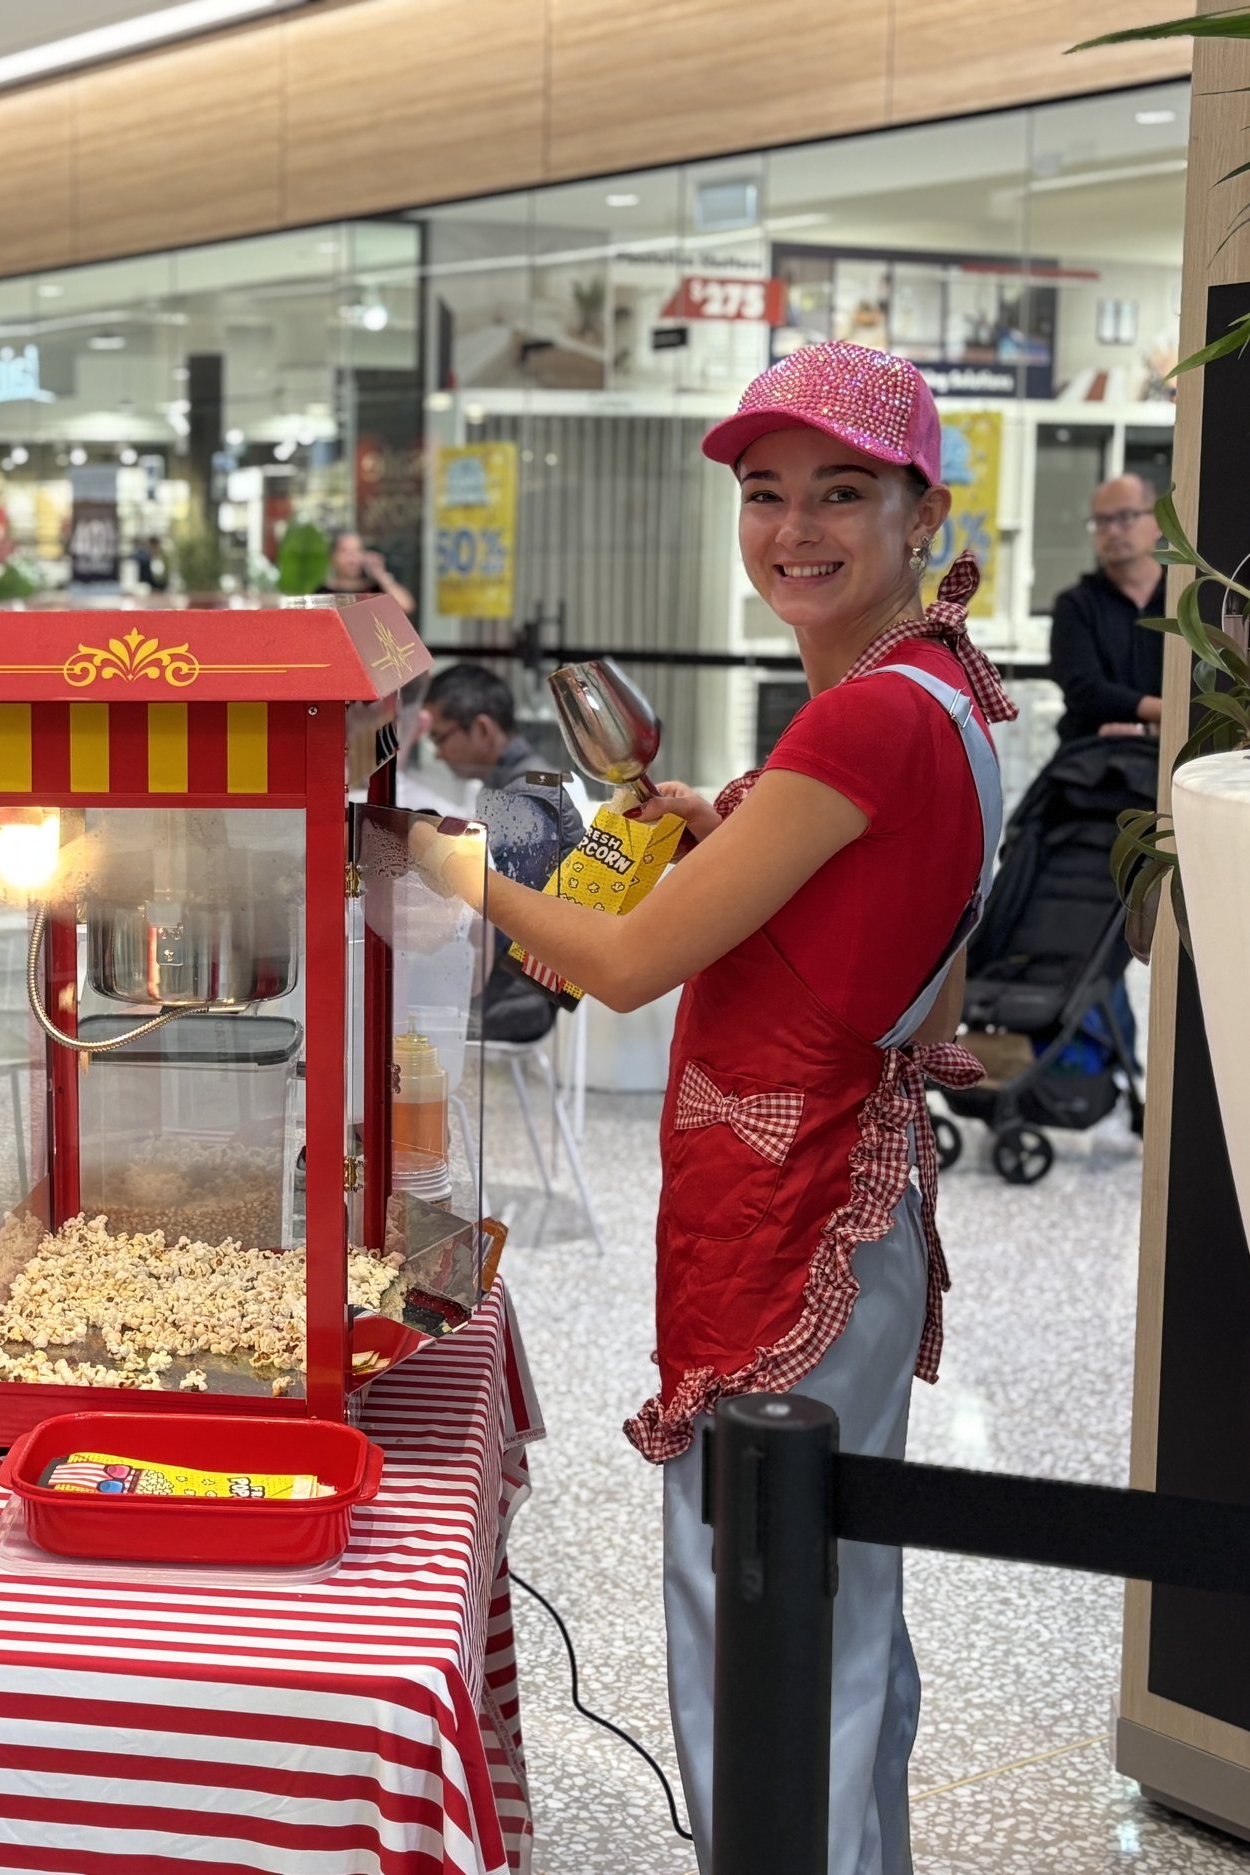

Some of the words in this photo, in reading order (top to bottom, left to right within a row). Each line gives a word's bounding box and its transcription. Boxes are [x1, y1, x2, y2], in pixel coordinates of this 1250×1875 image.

[689, 278, 766, 319] $275
[577, 836, 631, 874] PCORN
[584, 826, 622, 850] RESH
